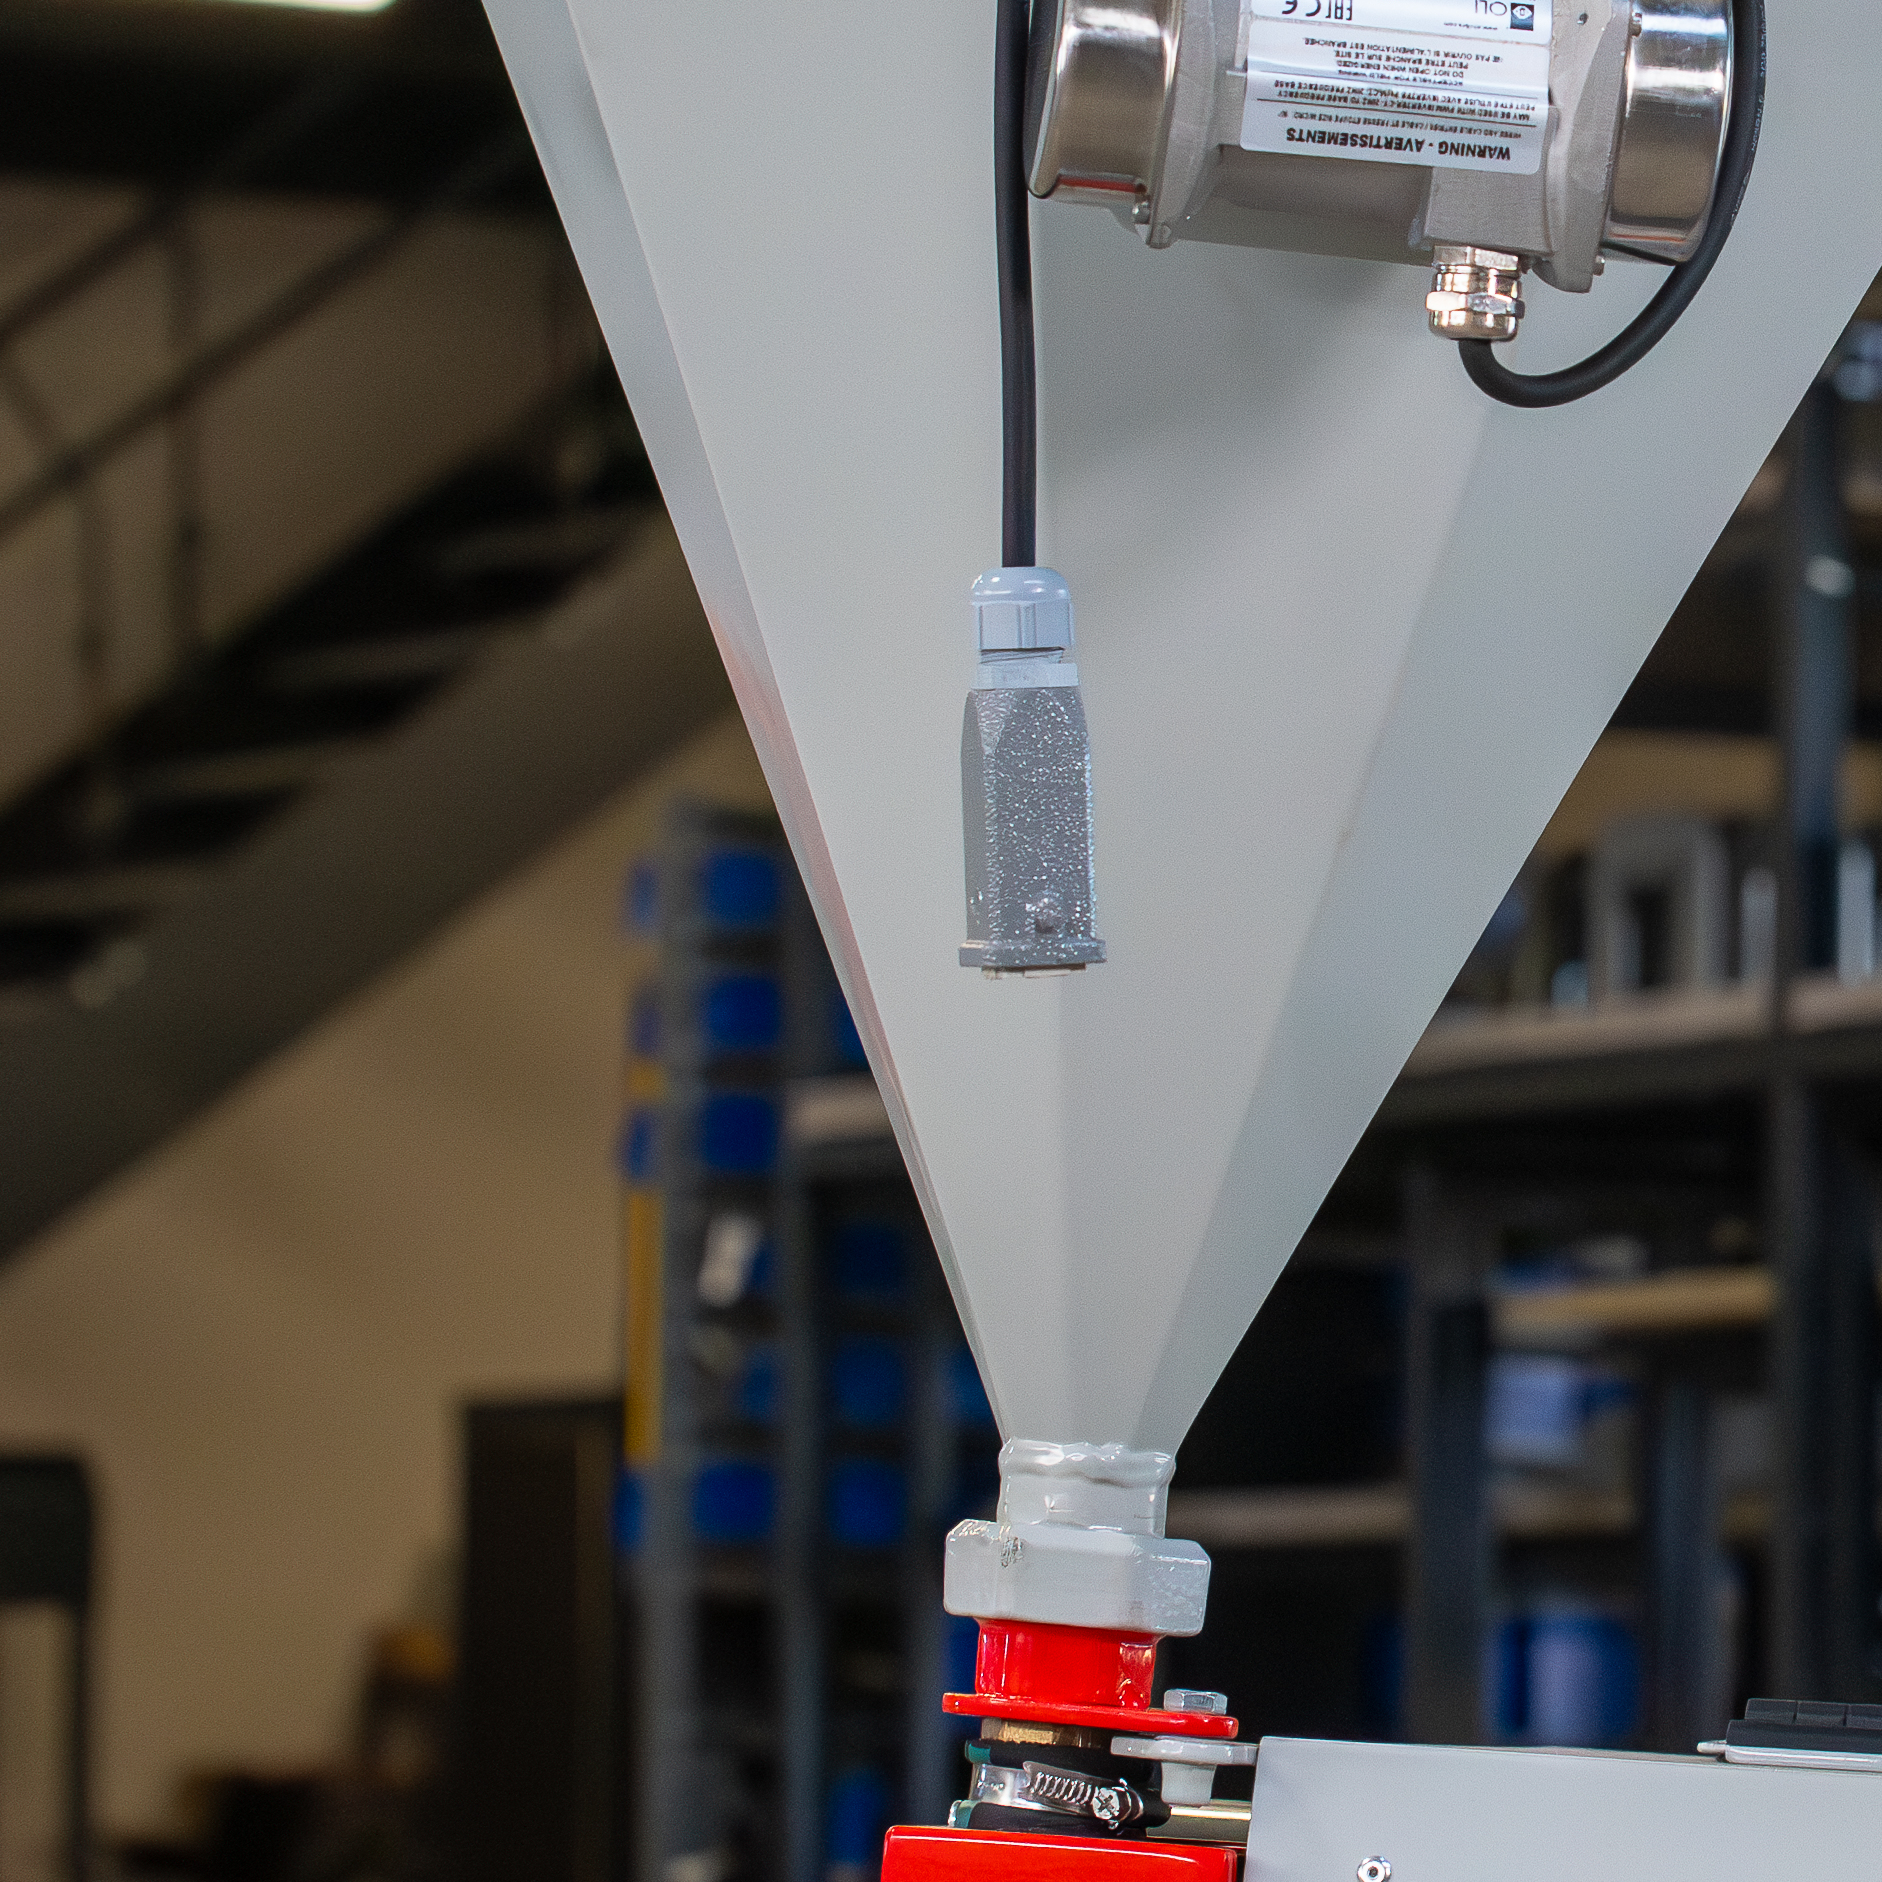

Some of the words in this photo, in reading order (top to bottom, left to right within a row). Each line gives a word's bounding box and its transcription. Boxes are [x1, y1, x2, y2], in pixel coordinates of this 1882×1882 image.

[1475, 0, 1507, 16] OLI
[1355, 52, 1364, 60] LE
[1367, 53, 1382, 61] SUR
[1385, 54, 1423, 65] BRANCHE
[1443, 51, 1472, 60] OUVRIR
[1475, 54, 1490, 62] PAS
[1425, 59, 1445, 68] ETRE
[1448, 61, 1468, 69] PEUT
[1383, 64, 1406, 73] WHEN
[1409, 67, 1431, 75] OPEN
[1501, 111, 1511, 119] BE
[1513, 113, 1529, 121] MAY
[1286, 128, 1425, 152] AVERTISSEMENTS
[1438, 141, 1510, 161] WARNING
